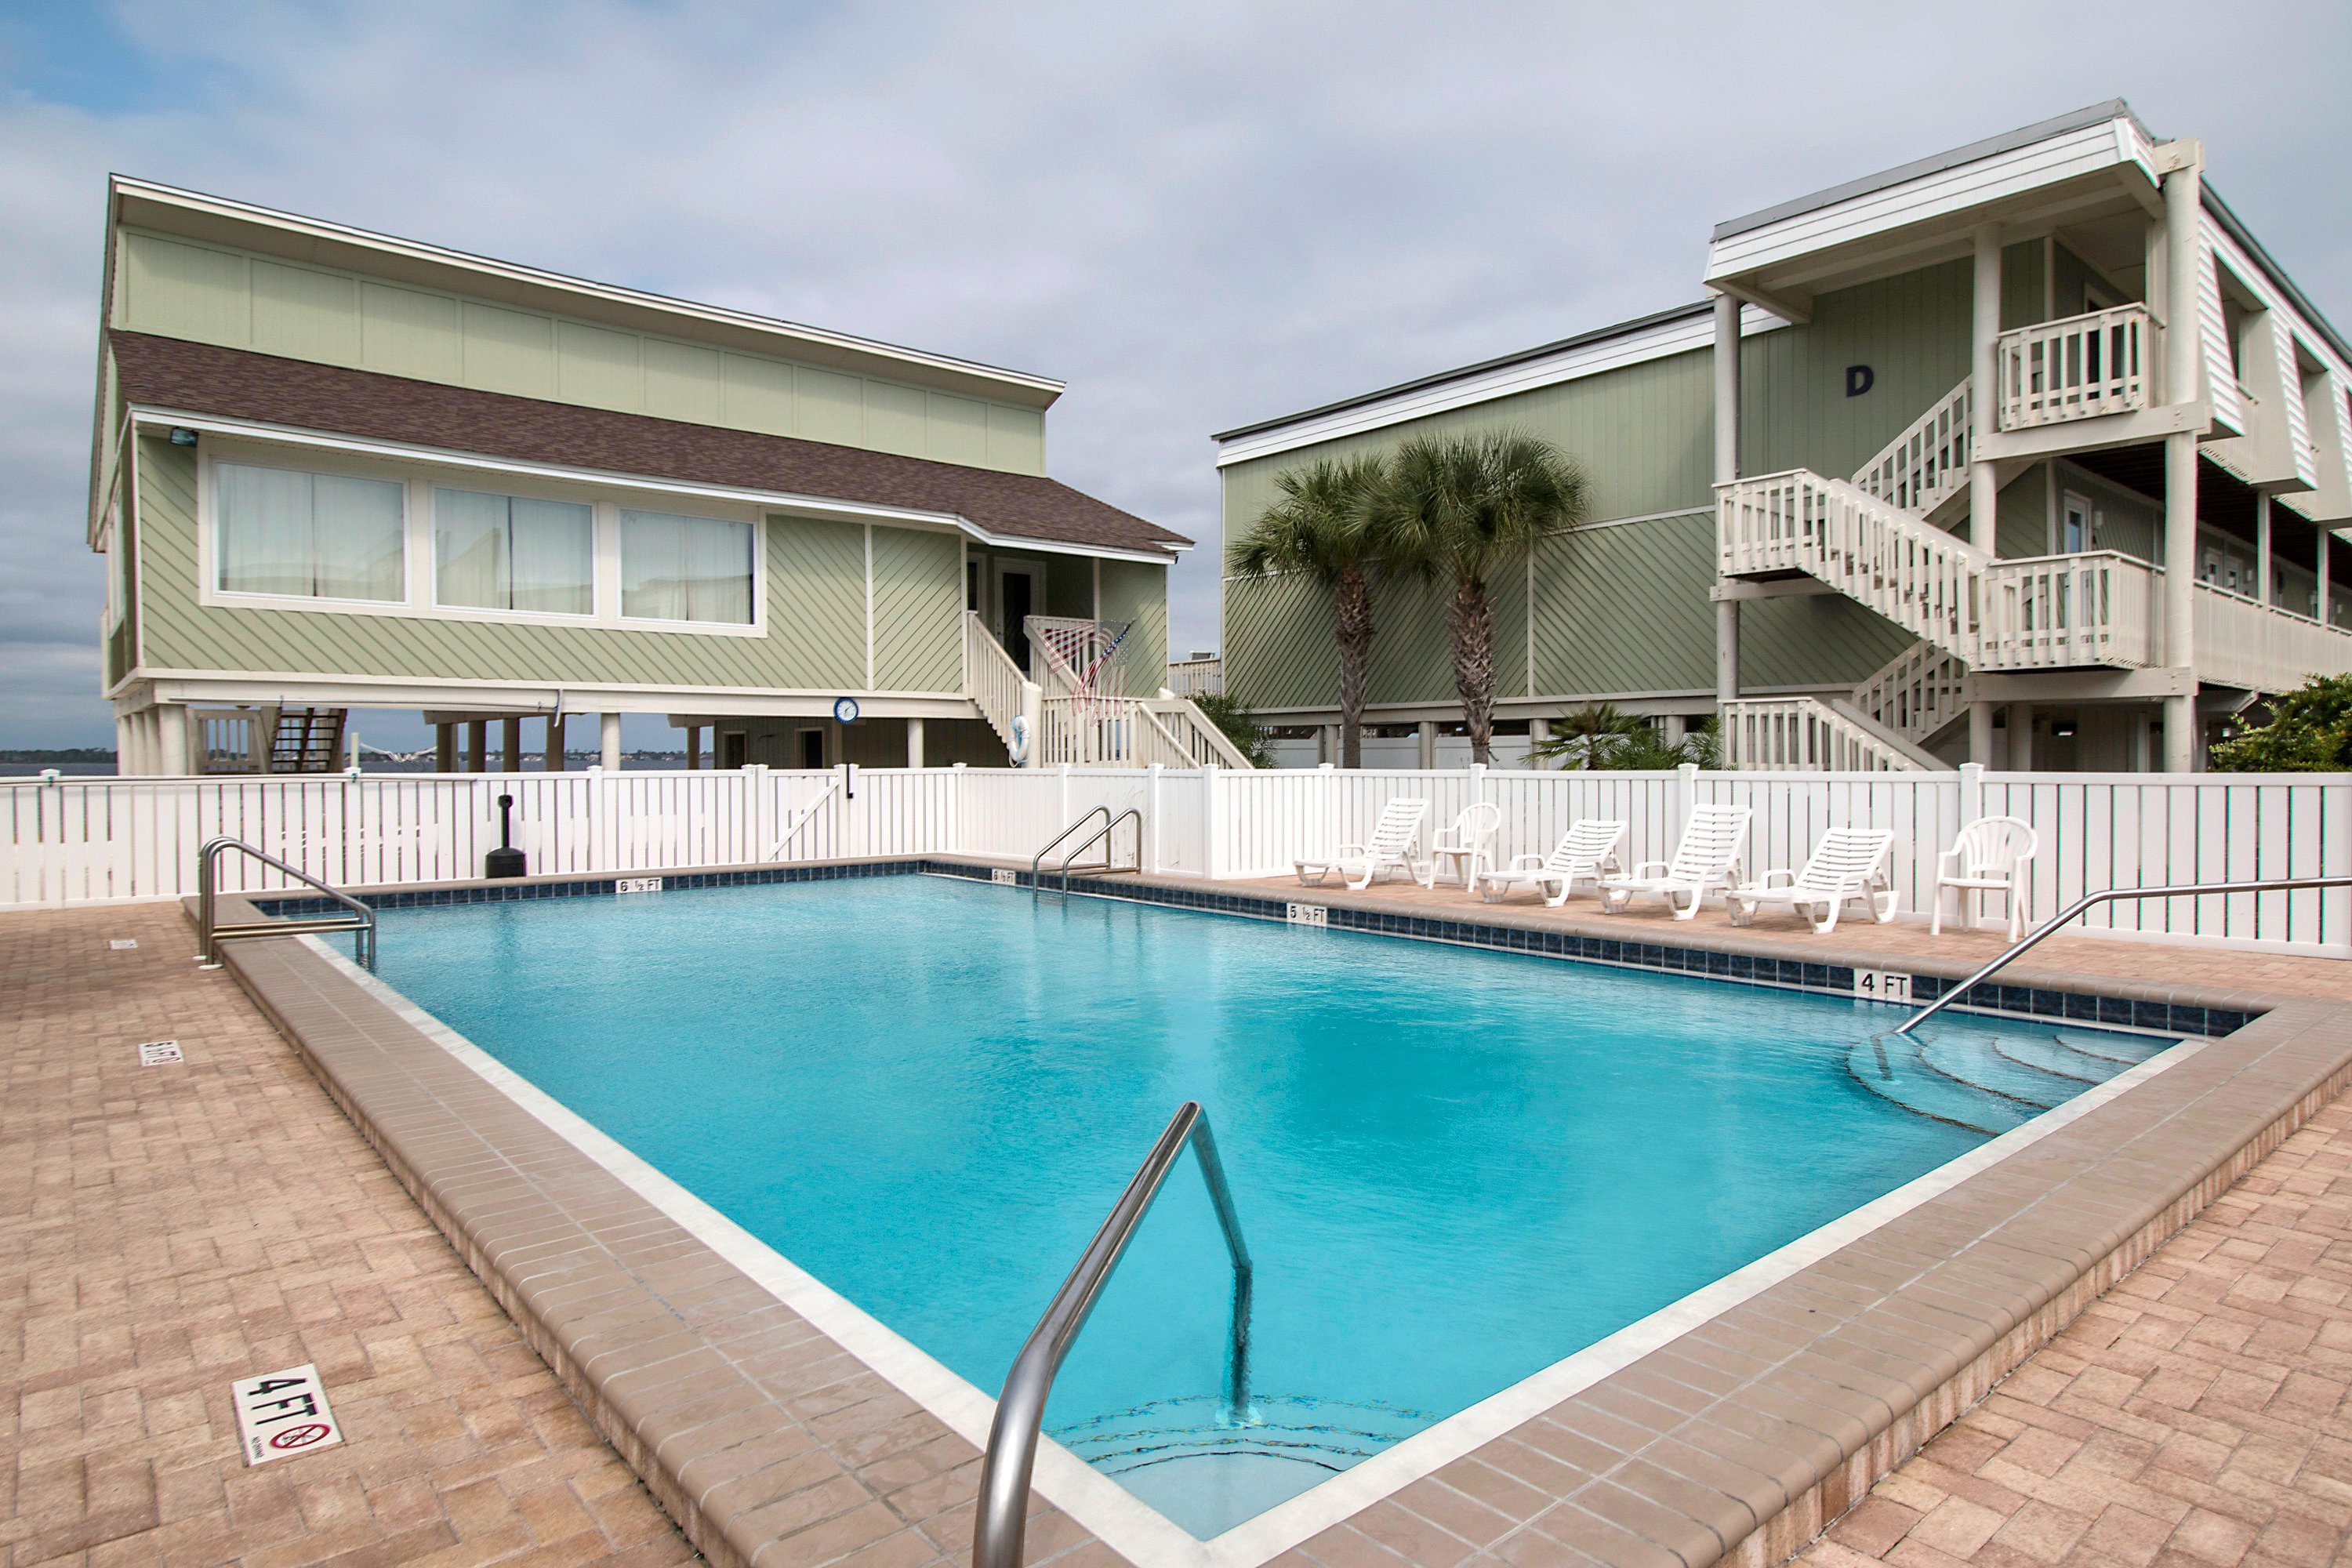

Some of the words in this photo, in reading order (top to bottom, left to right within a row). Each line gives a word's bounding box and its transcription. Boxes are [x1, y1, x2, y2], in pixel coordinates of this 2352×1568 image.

[1846, 365, 1875, 397] D
[620, 880, 628, 891] 6
[647, 879, 660, 891] FT
[1007, 872, 1014, 883] FT
[1290, 906, 1297, 918] 5
[1313, 908, 1325, 922] FT
[1861, 973, 1875, 992] 4
[1883, 975, 1907, 996] FT
[247, 1377, 308, 1396] 4
[250, 1392, 318, 1425] FT
